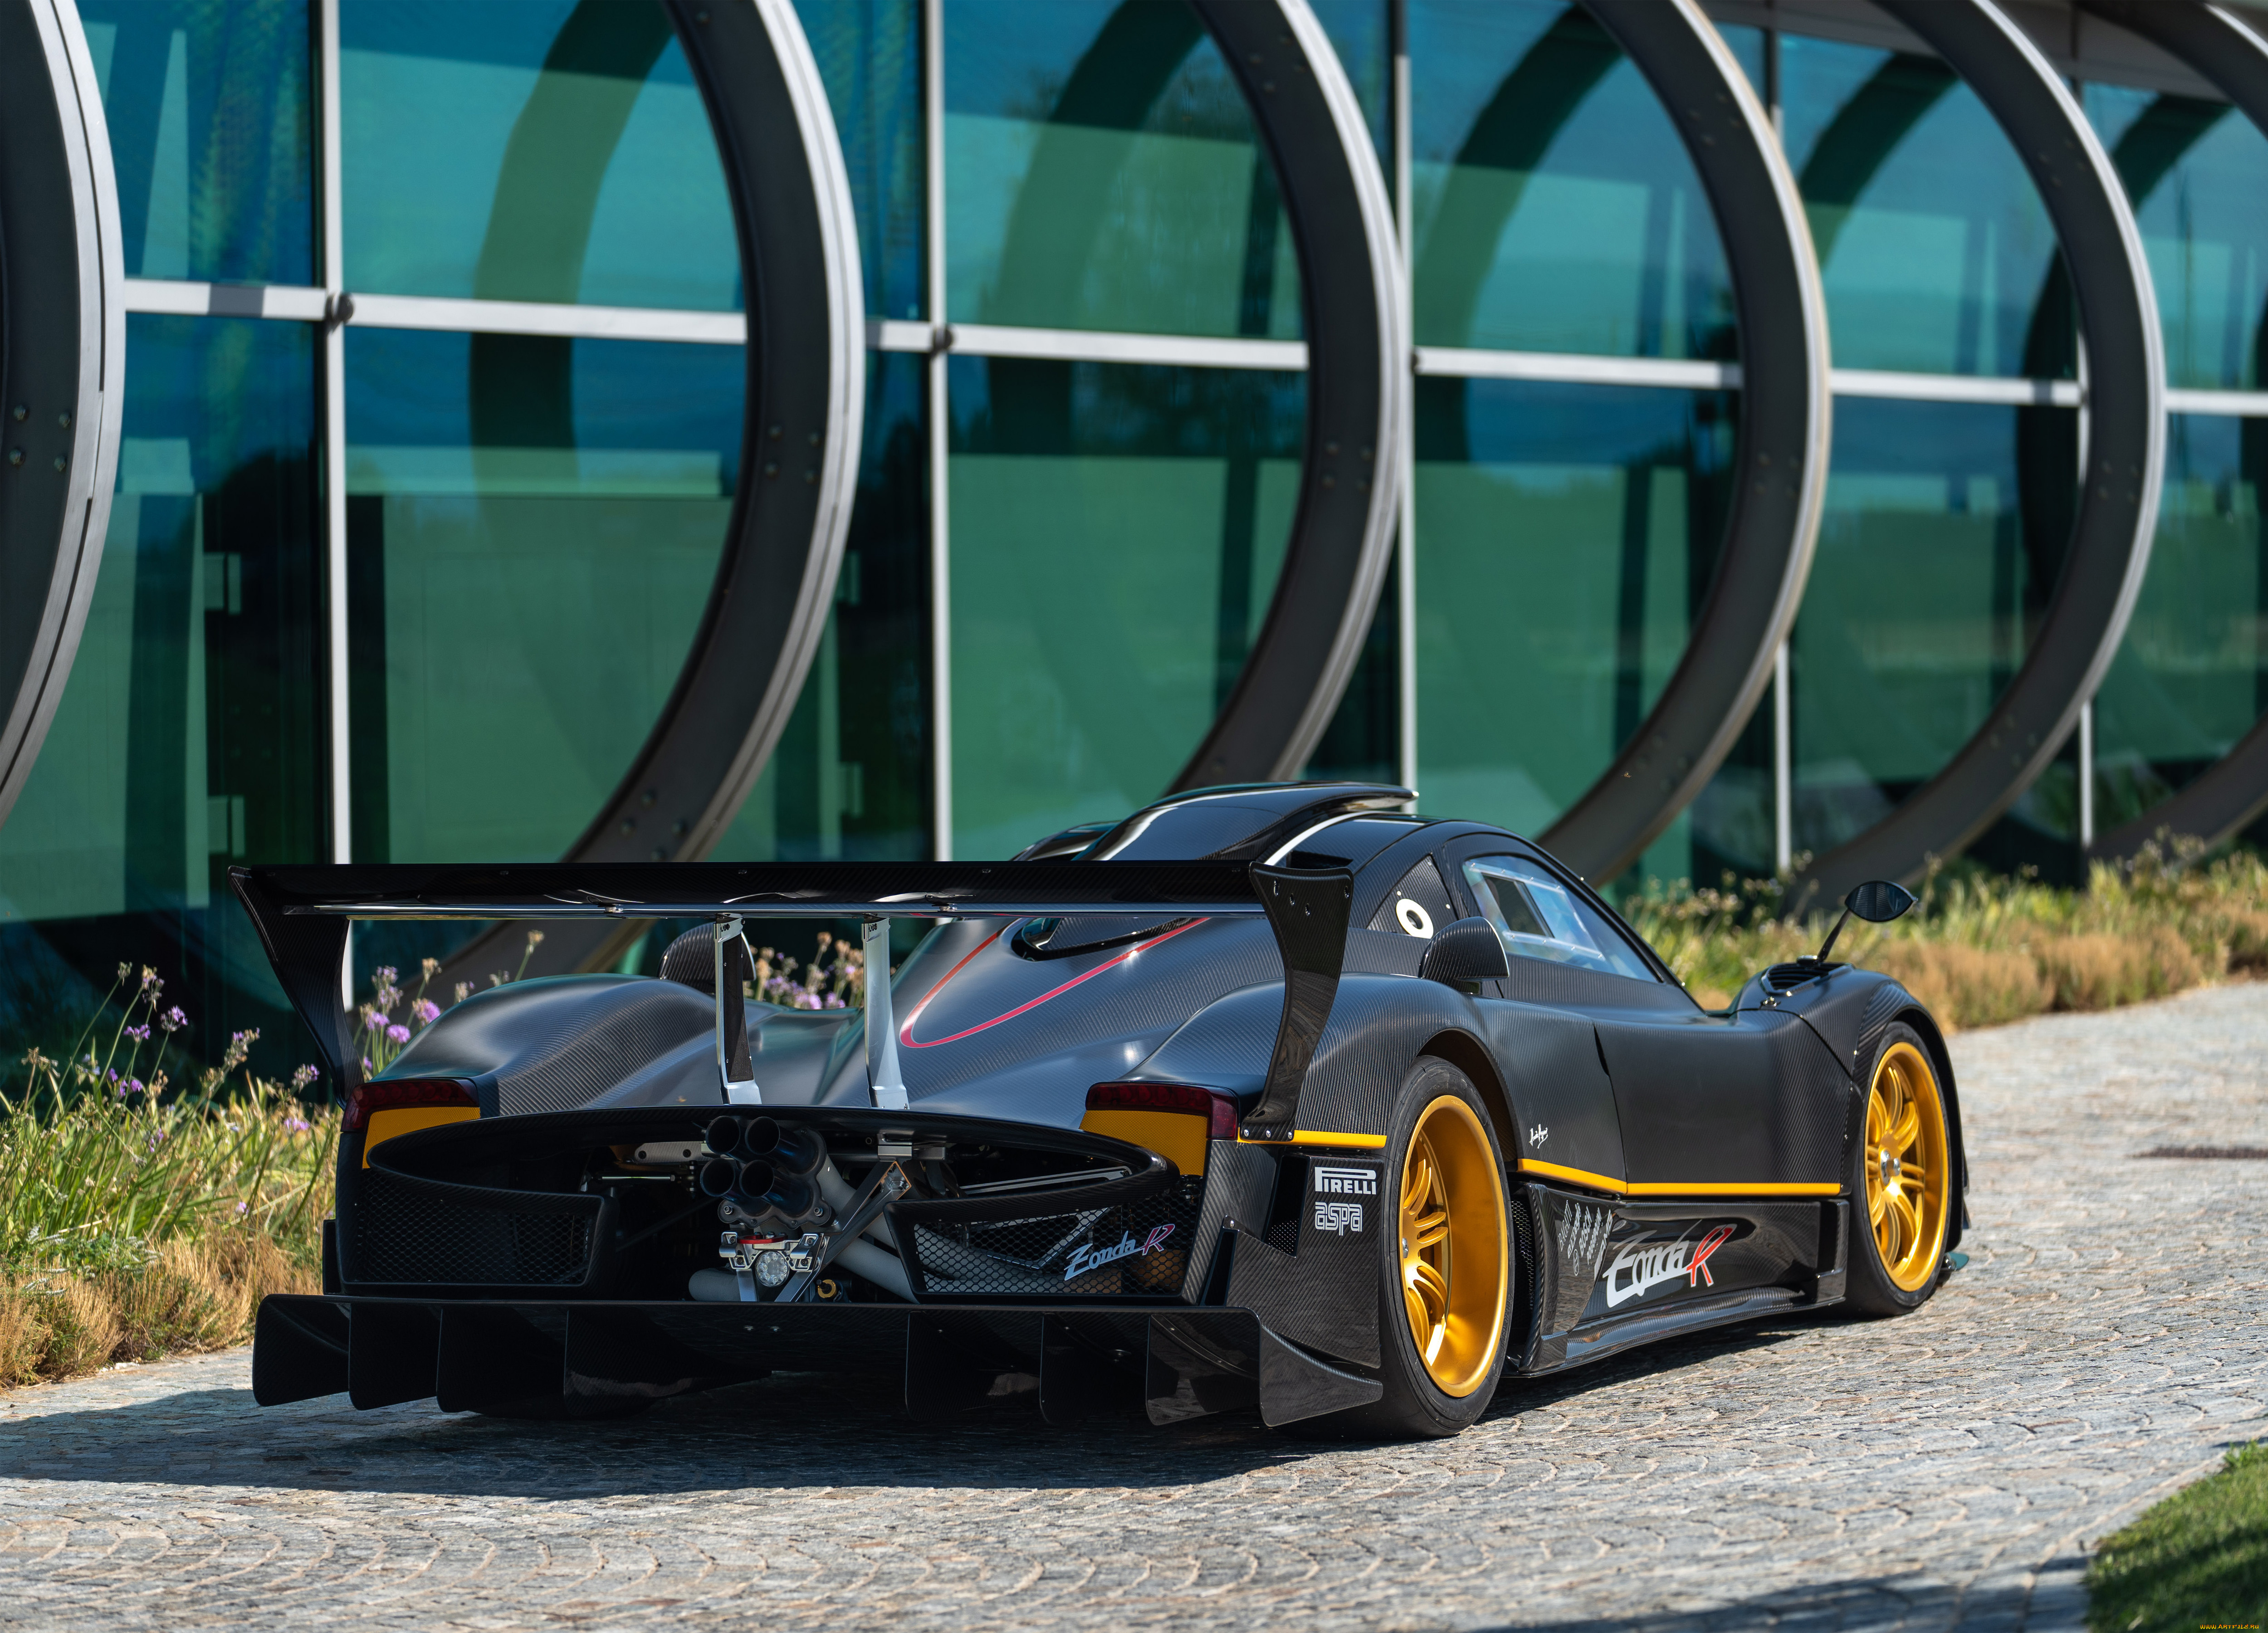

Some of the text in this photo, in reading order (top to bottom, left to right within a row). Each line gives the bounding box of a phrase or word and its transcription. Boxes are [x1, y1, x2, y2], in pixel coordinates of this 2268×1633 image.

[1315, 1167, 1376, 1195] PIRELLI
[1315, 1202, 1362, 1236] aspa
[1579, 1206, 1592, 1258] BOSCH
[1064, 1224, 1175, 1281] Zonda R
[1602, 1219, 1737, 1308] Zonda R
